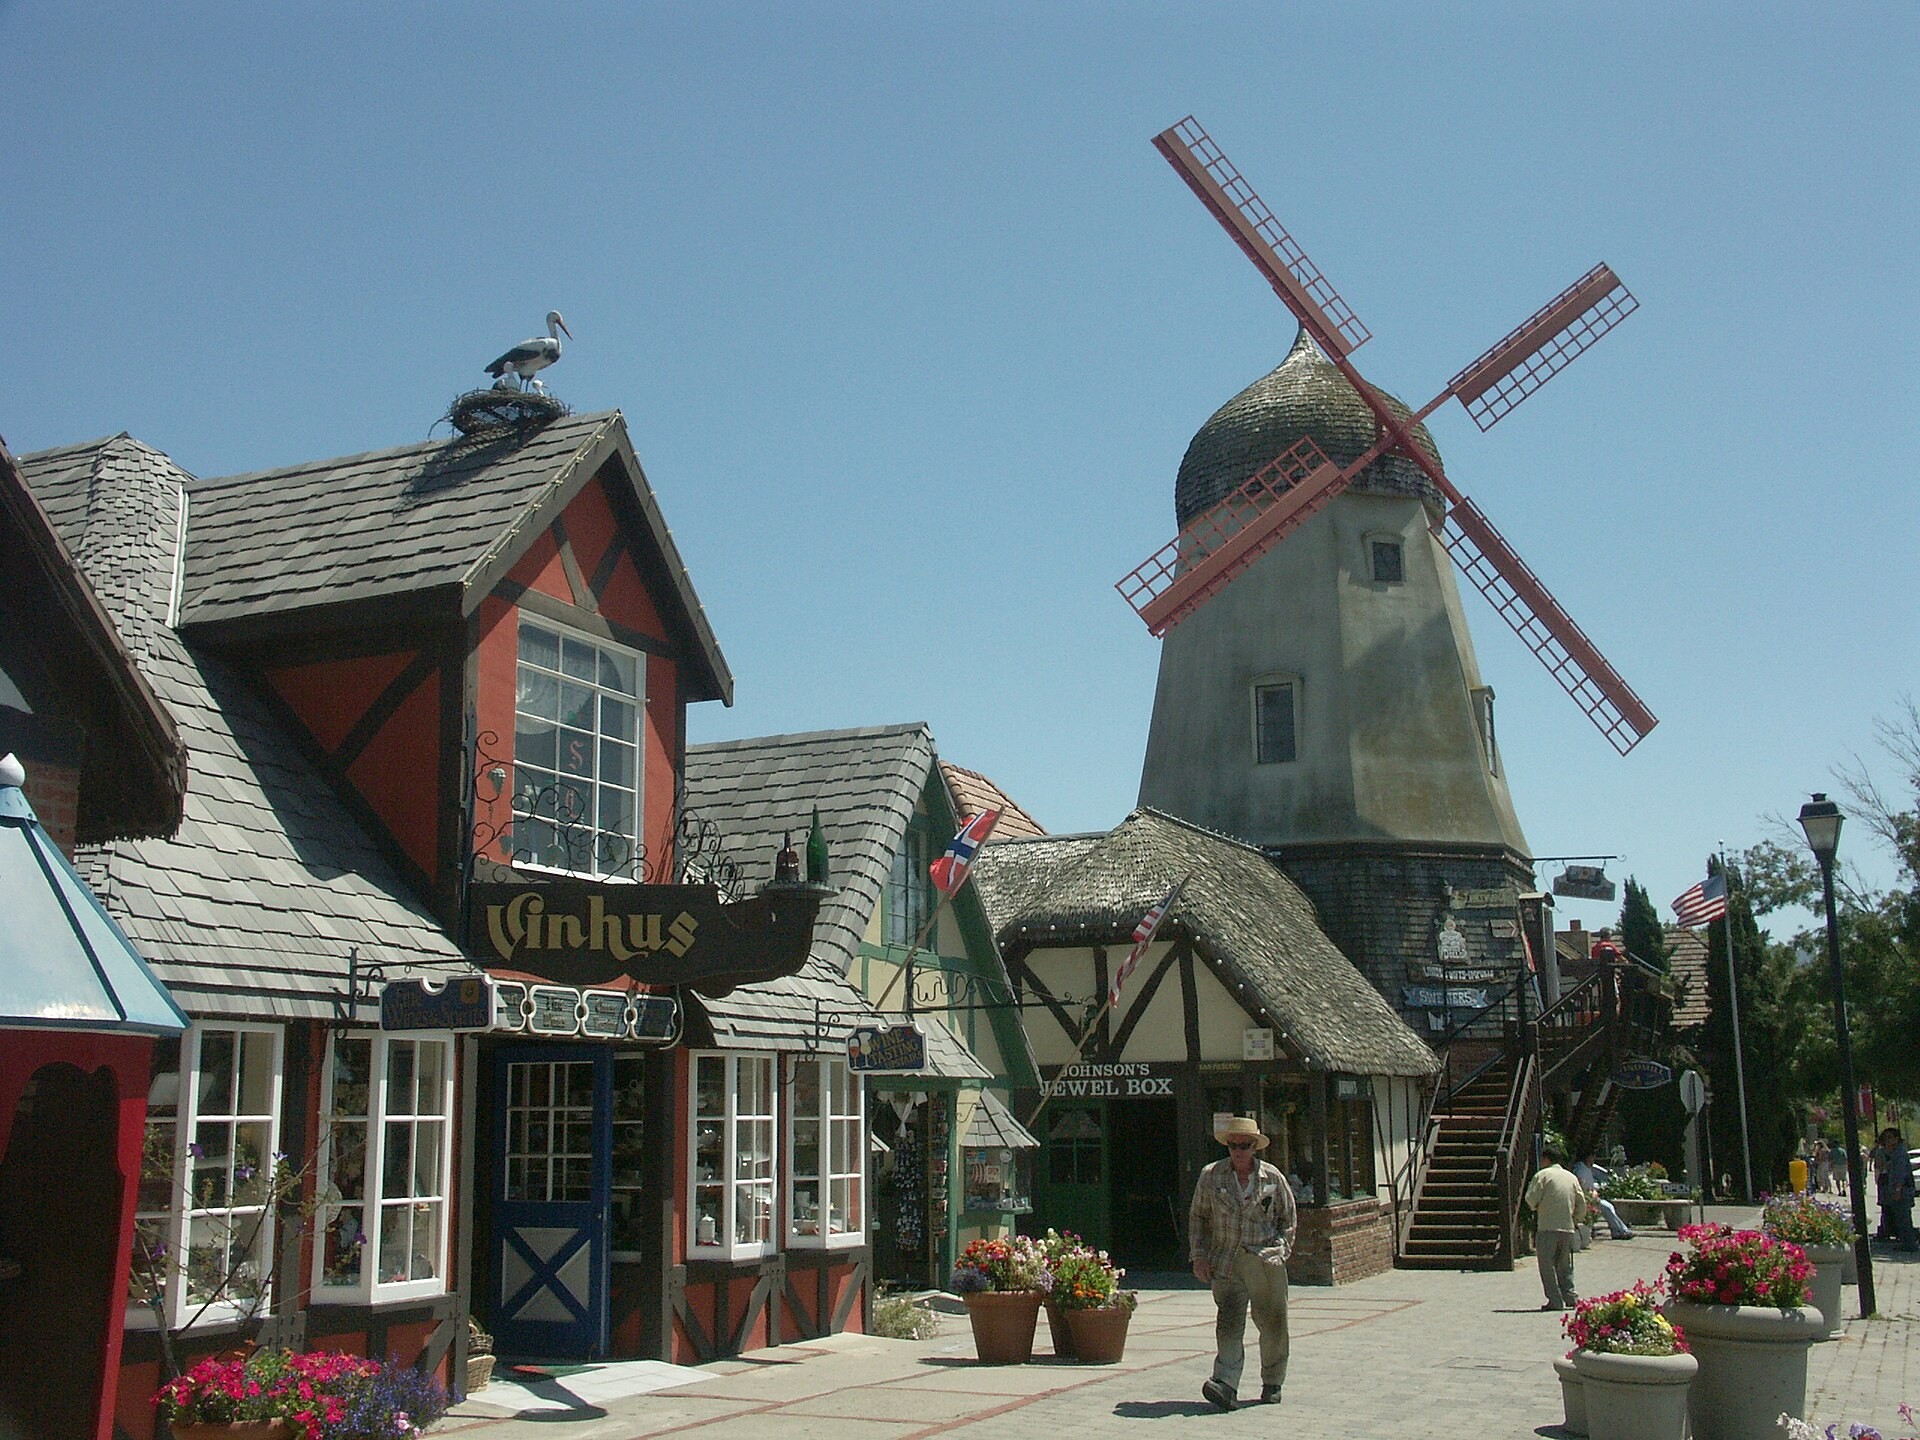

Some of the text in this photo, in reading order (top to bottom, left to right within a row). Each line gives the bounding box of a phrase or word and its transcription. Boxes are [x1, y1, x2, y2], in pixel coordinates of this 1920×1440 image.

[486, 892, 699, 961] Vinhus
[868, 1029, 904, 1051] WINE
[869, 1040, 919, 1066] TASTING
[1062, 1064, 1150, 1077] JOHNSON'S
[1039, 1078, 1174, 1097] JEWEL BOX
